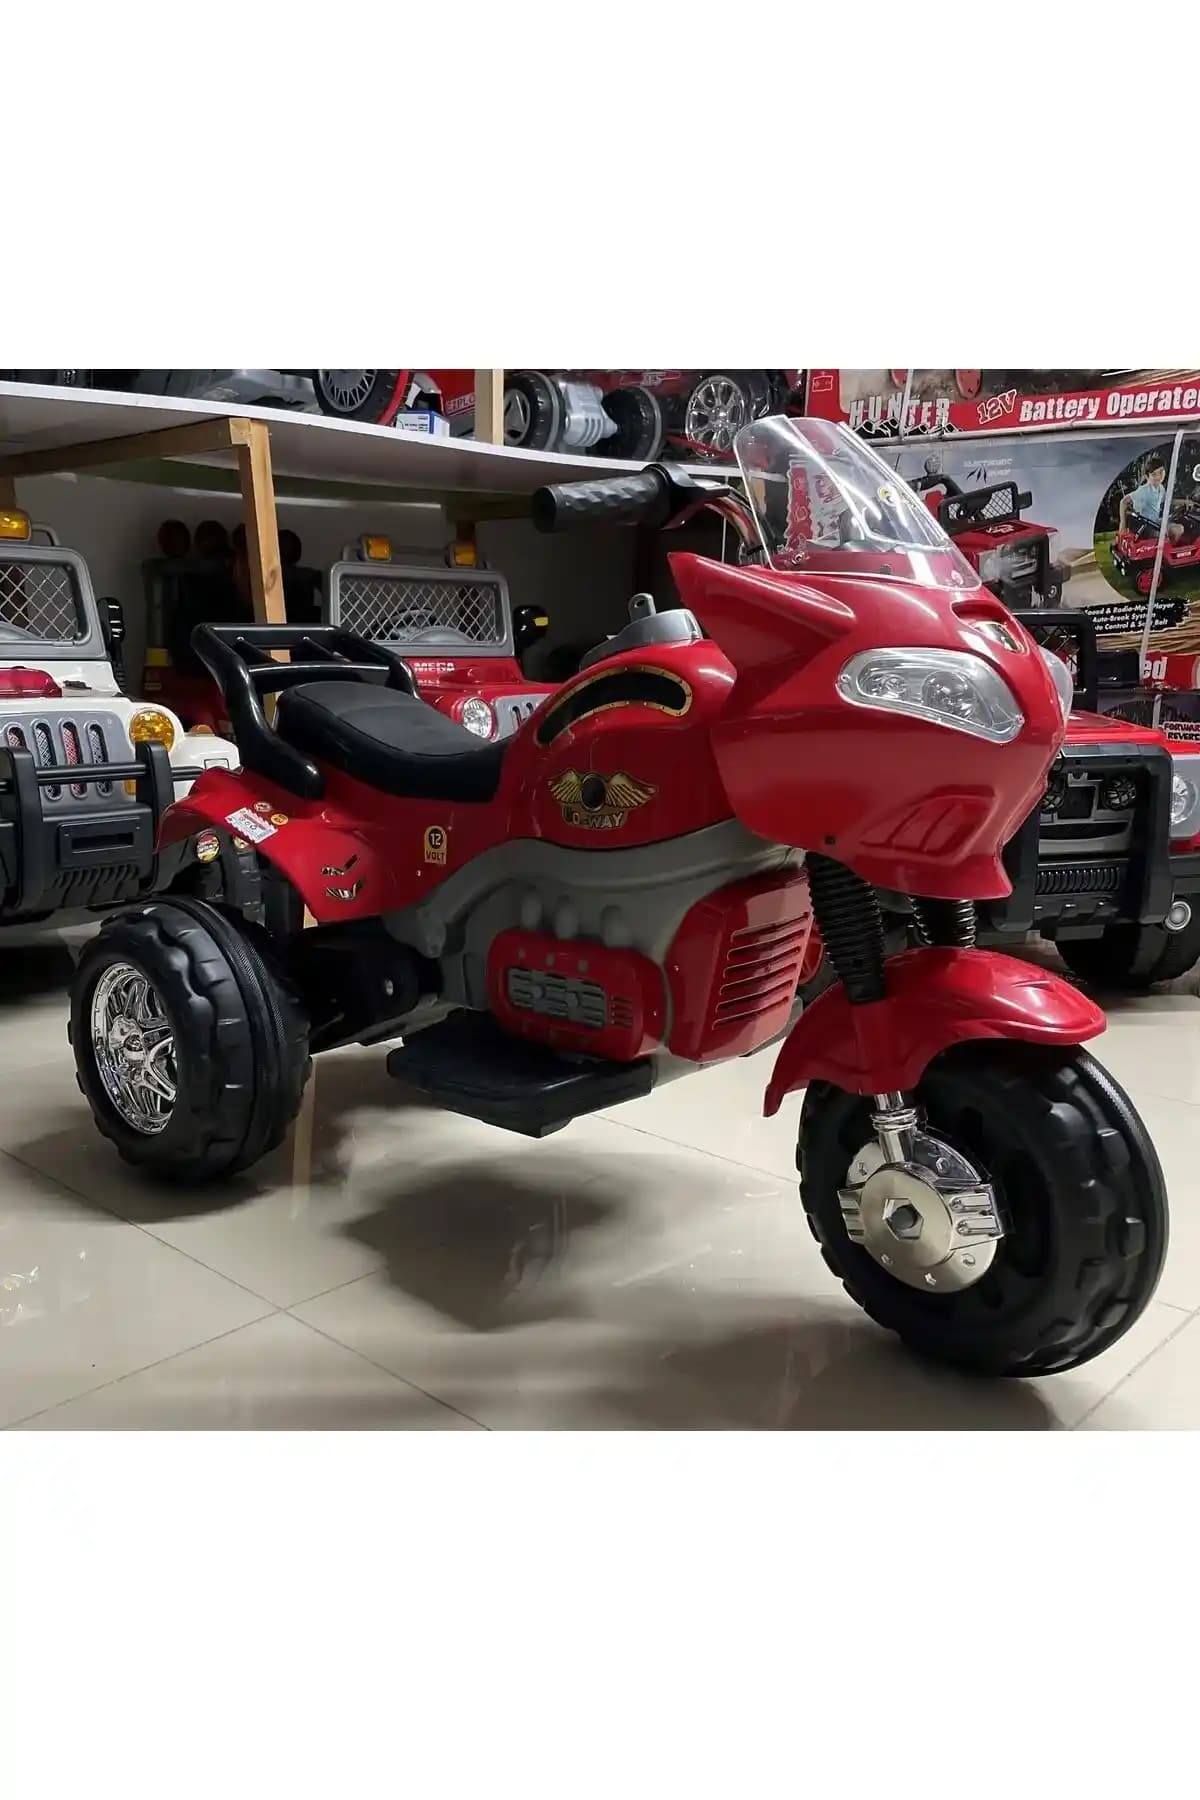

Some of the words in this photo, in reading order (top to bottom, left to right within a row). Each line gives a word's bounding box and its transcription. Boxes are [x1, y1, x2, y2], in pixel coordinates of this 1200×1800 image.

[977, 389, 1017, 424] 12V
[1019, 397, 1101, 422] Battery
[1106, 386, 1200, 417] Operate
[1143, 656, 1168, 680] ed
[430, 833, 441, 846] 12
[425, 850, 446, 862] VOLT
